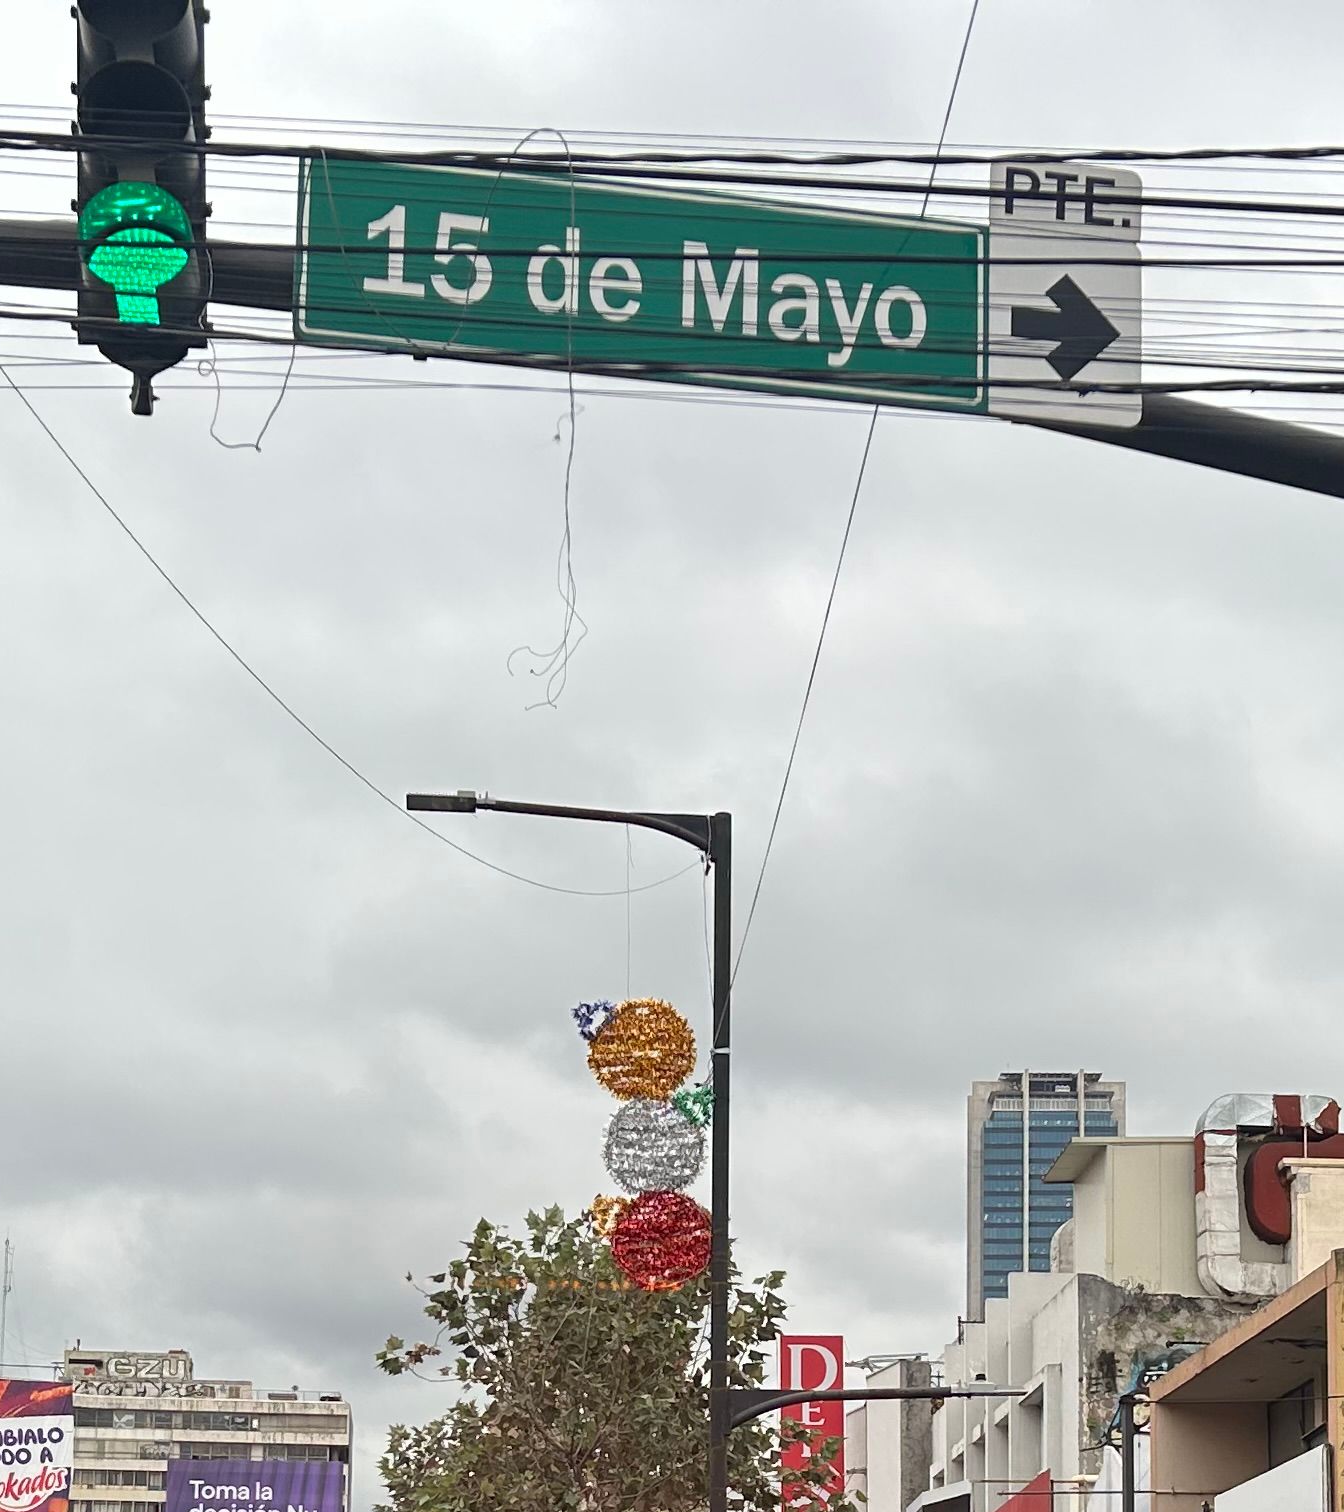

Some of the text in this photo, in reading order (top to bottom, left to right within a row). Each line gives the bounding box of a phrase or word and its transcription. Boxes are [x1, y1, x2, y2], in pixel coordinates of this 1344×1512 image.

[1002, 165, 1133, 229] PTE.
[361, 204, 928, 367] 15 de Mayo
[40, 1446, 54, 1463] A
[189, 1480, 273, 1500] Toma la
